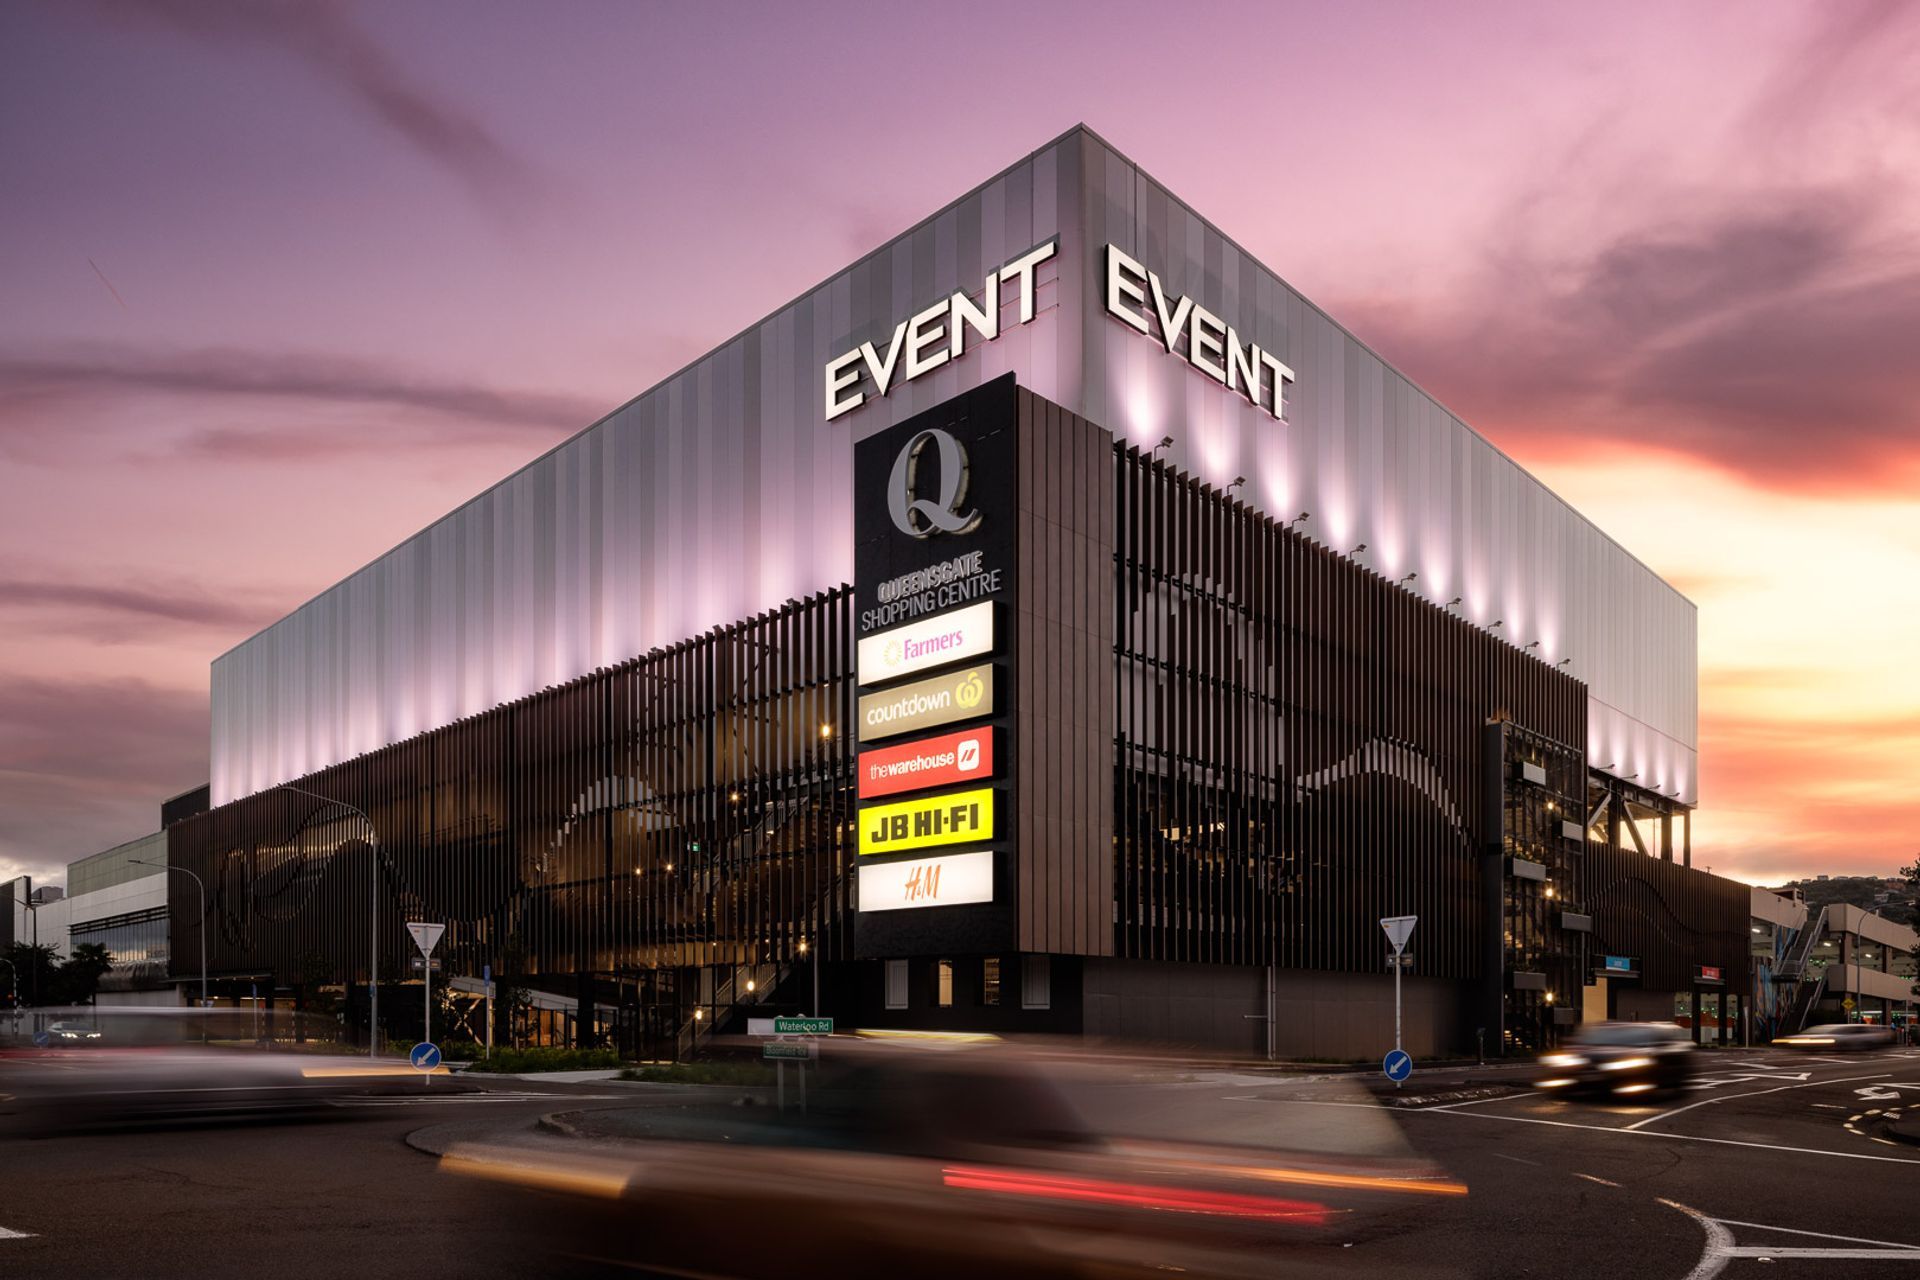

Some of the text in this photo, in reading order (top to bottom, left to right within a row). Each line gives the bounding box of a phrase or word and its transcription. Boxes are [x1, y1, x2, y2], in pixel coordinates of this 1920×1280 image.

[826, 241, 1057, 421] EVENT
[1106, 243, 1295, 420] EVENT
[887, 428, 983, 538] Q
[877, 550, 983, 603] QUEENSGATE
[862, 568, 1002, 632] SHOPPING CENTRE
[904, 630, 963, 660] Farmers
[867, 691, 951, 725] countdown
[871, 814, 909, 843] JB
[905, 864, 941, 901] H&M
[779, 1021, 829, 1032] Waterloo Rd
